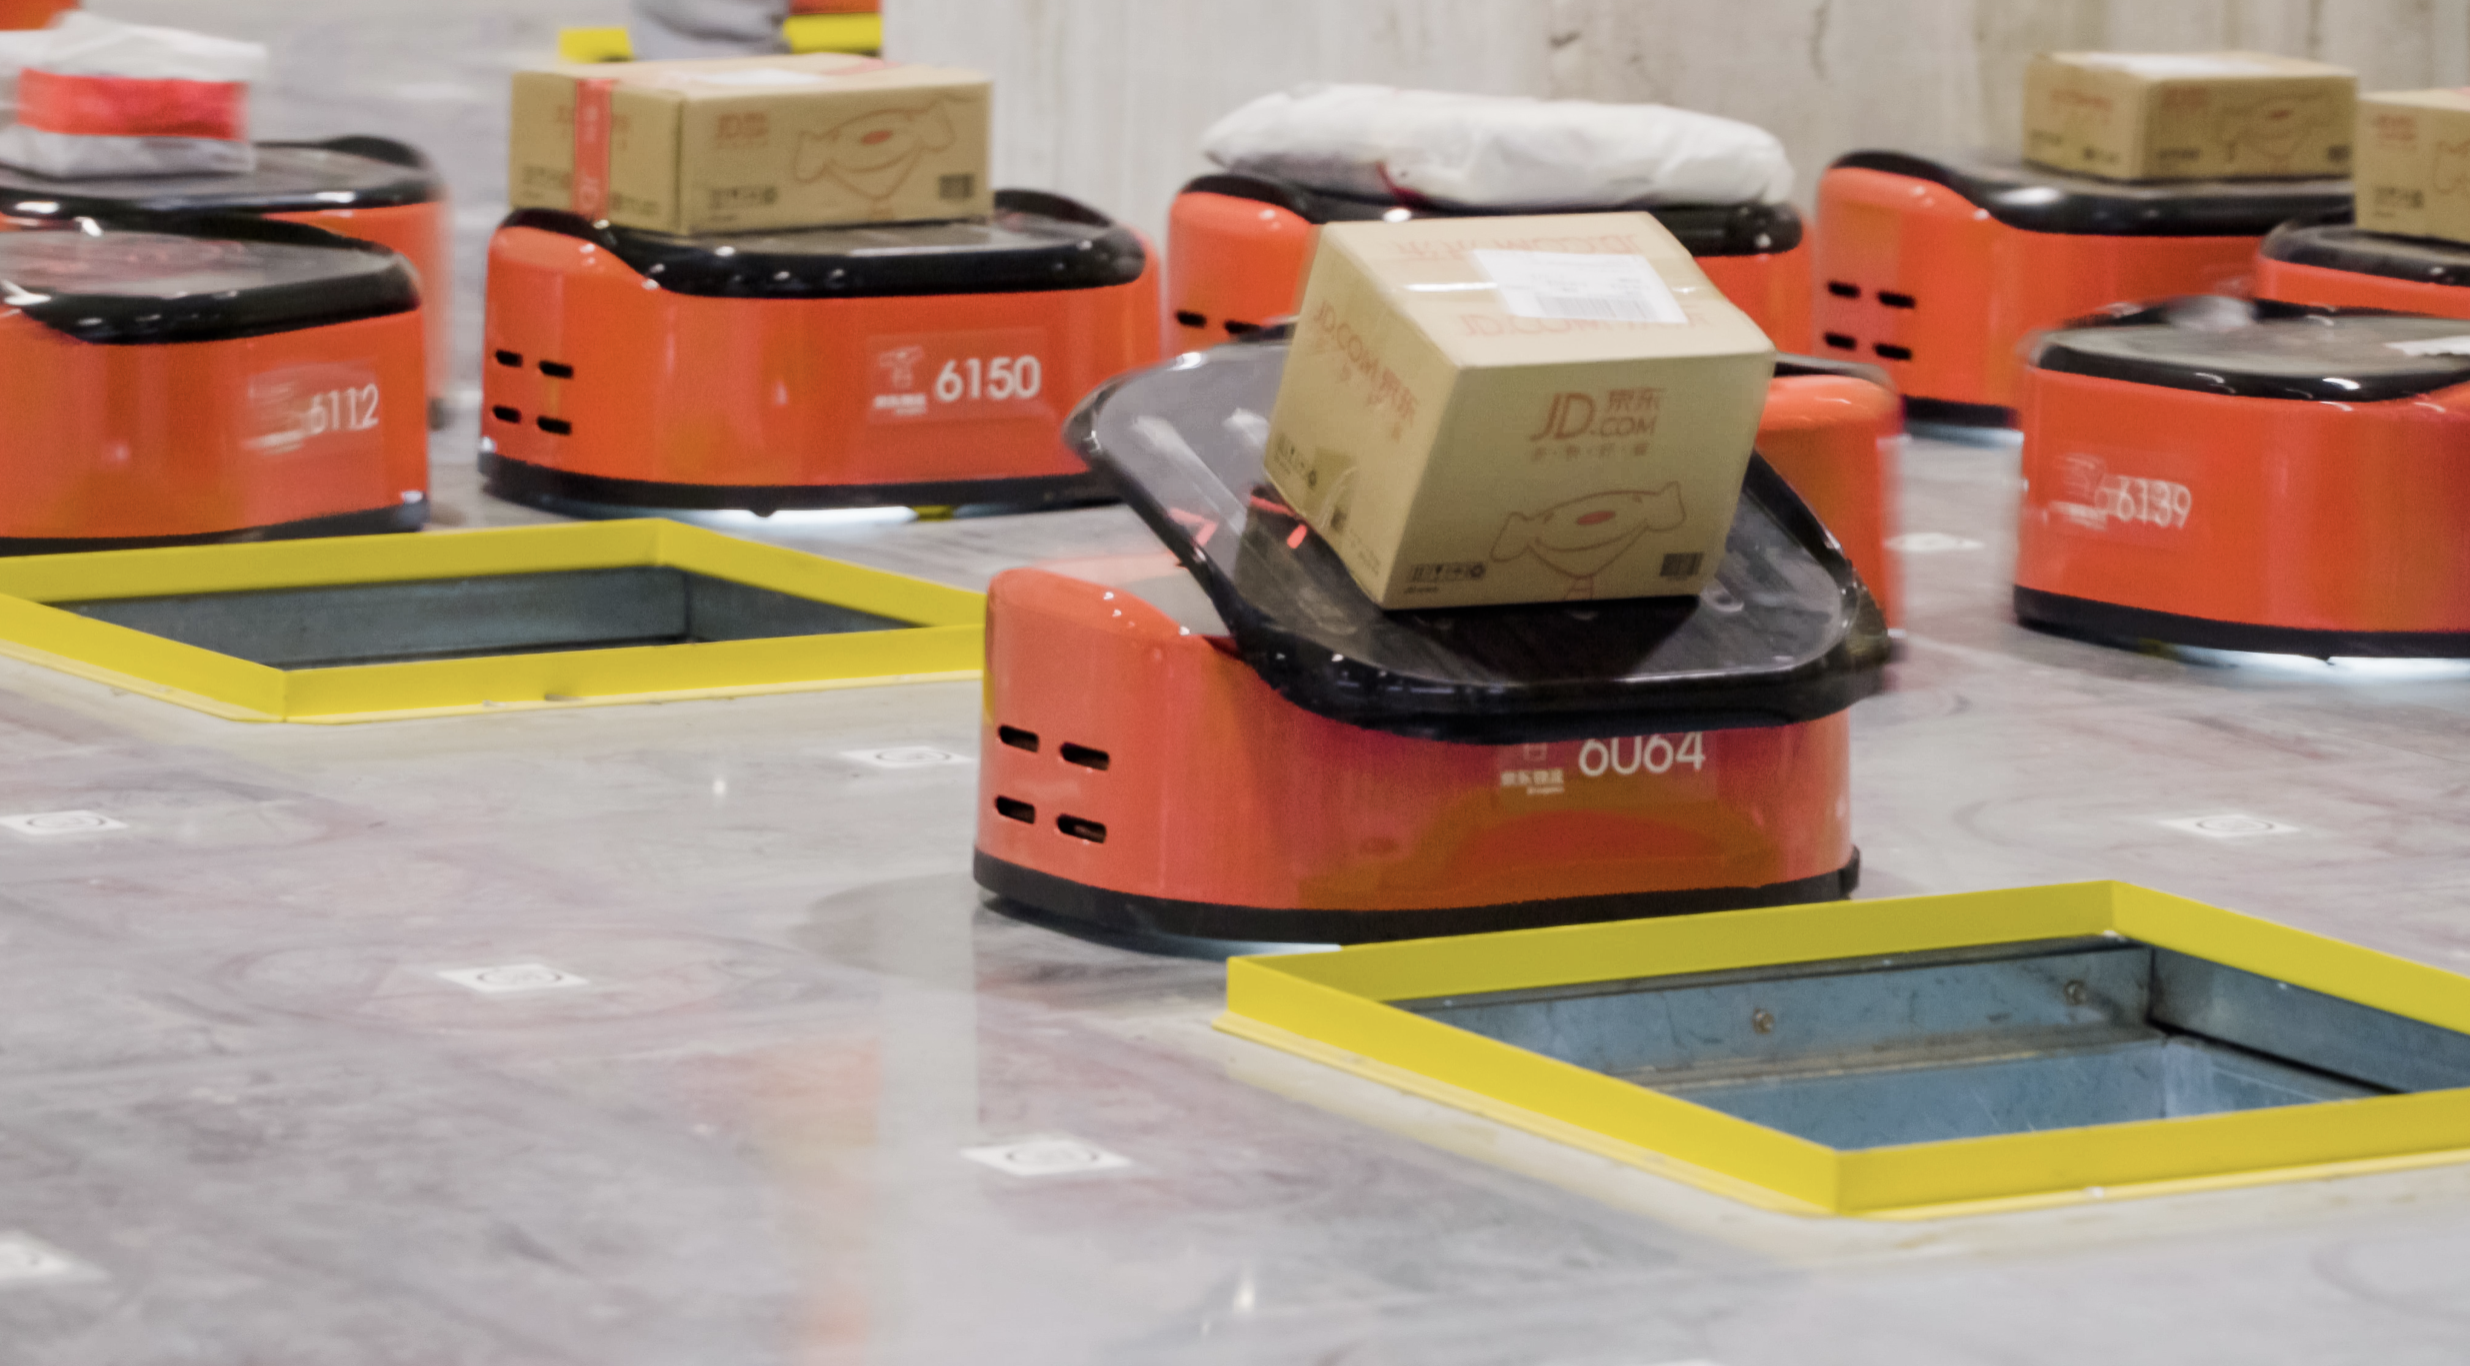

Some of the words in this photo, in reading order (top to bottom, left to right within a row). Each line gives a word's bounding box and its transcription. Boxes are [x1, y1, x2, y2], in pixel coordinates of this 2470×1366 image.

[934, 355, 1042, 403] 6150
[309, 383, 379, 435] 6112
[2117, 475, 2191, 529] 6139
